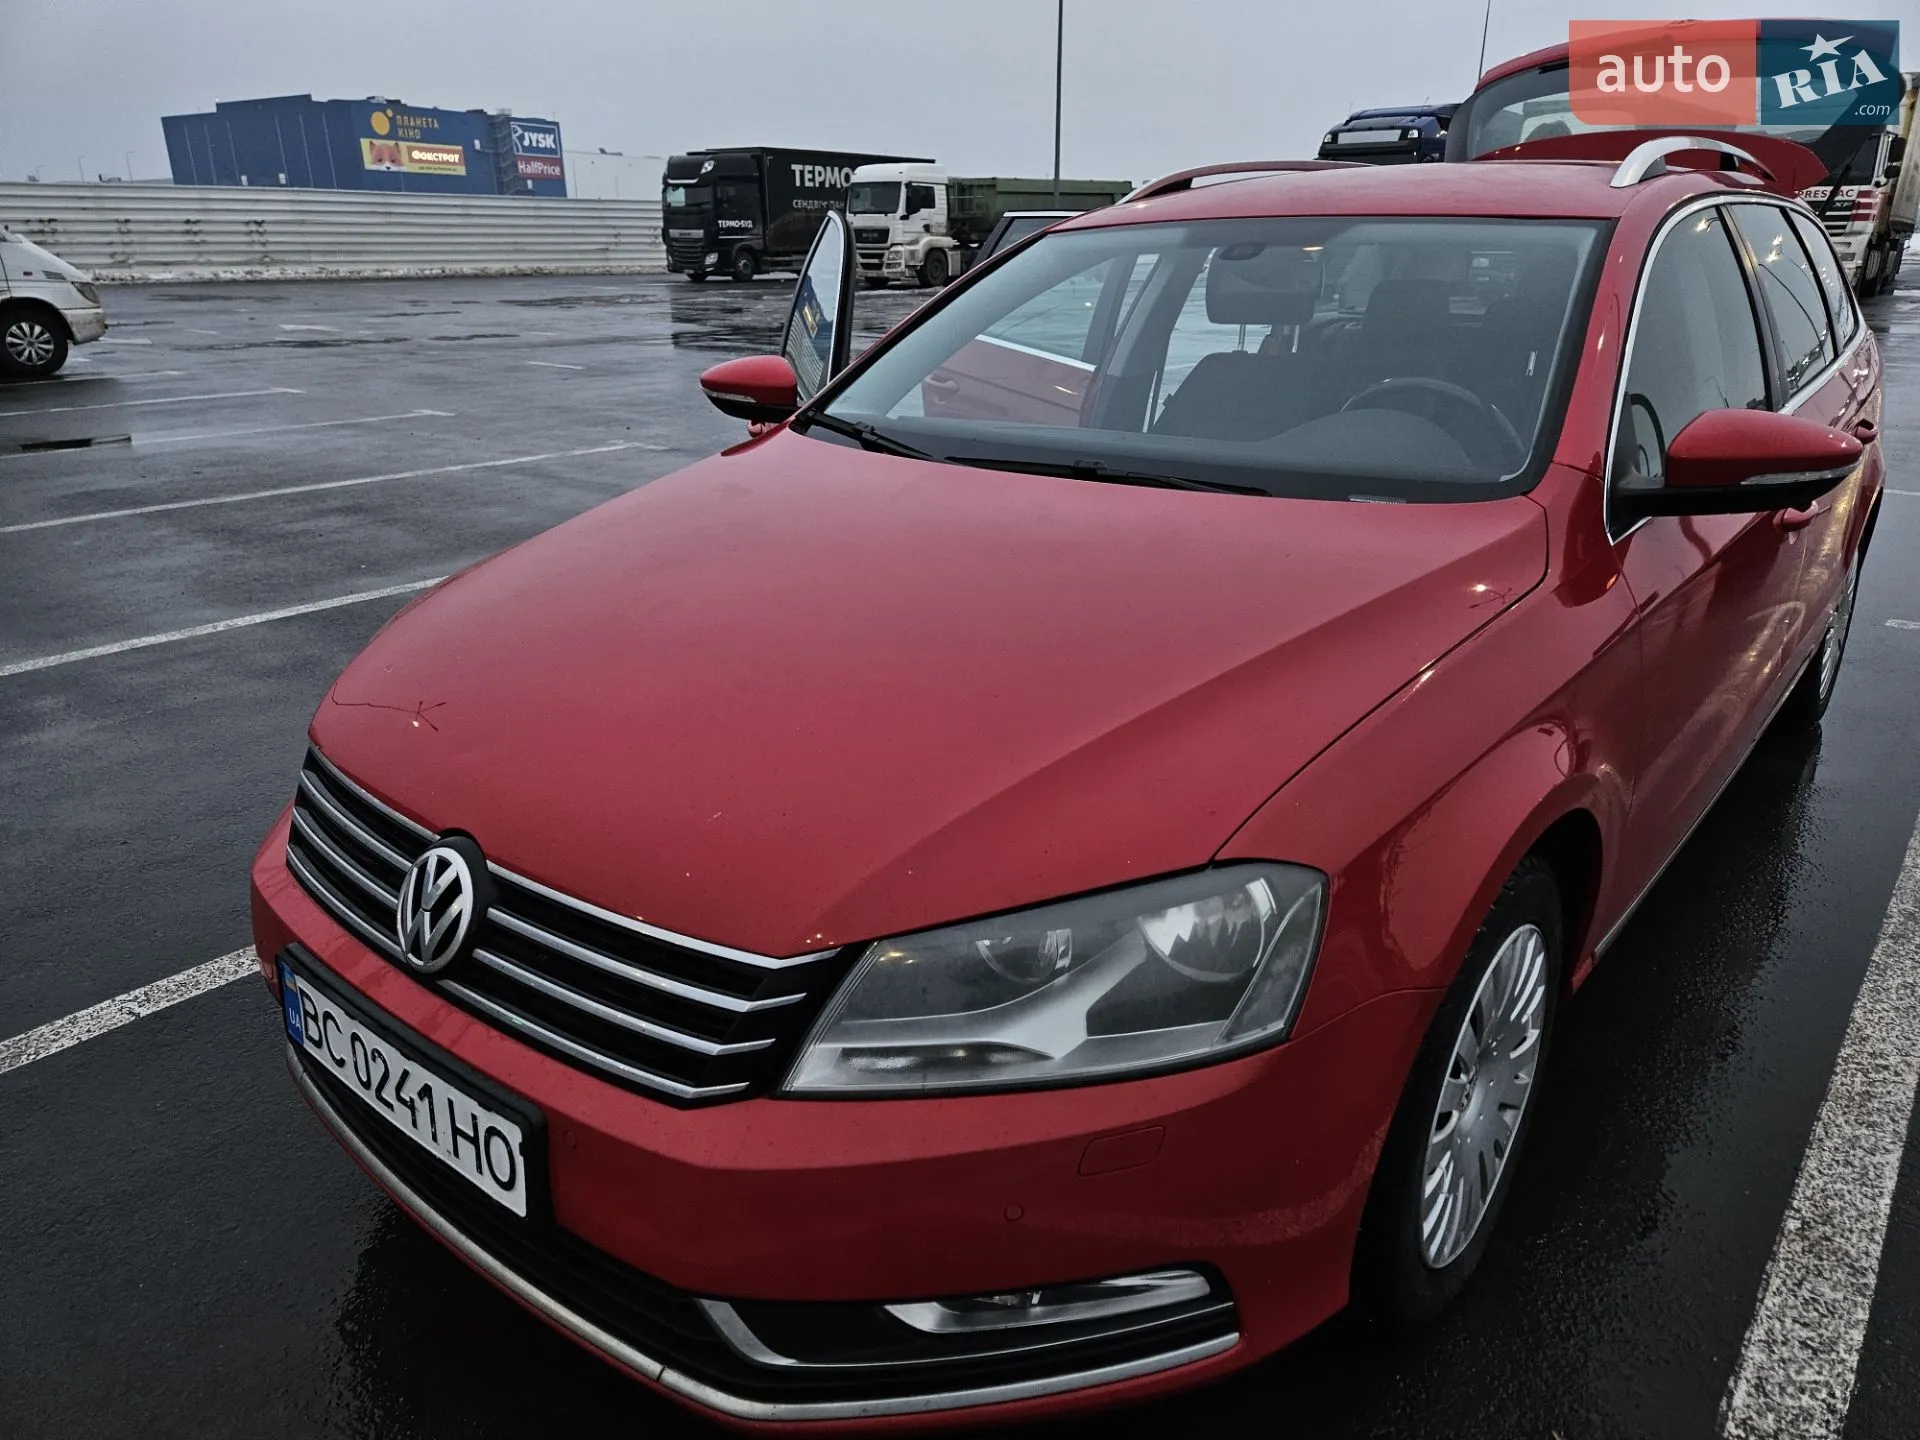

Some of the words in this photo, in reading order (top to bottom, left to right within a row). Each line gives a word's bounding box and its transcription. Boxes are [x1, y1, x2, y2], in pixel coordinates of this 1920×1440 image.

[396, 115, 439, 129] ПЛАНЕТА
[398, 128, 420, 139] КІНО
[523, 131, 556, 149] JYSK
[411, 149, 460, 163] ФОКСТРОТ
[517, 160, 561, 176] HalfPrice
[791, 164, 852, 189] ТЕРМО
[288, 1006, 303, 1031] UA
[298, 989, 346, 1068] BC
[350, 1031, 439, 1145] 0241
[448, 1097, 517, 1192] HO
